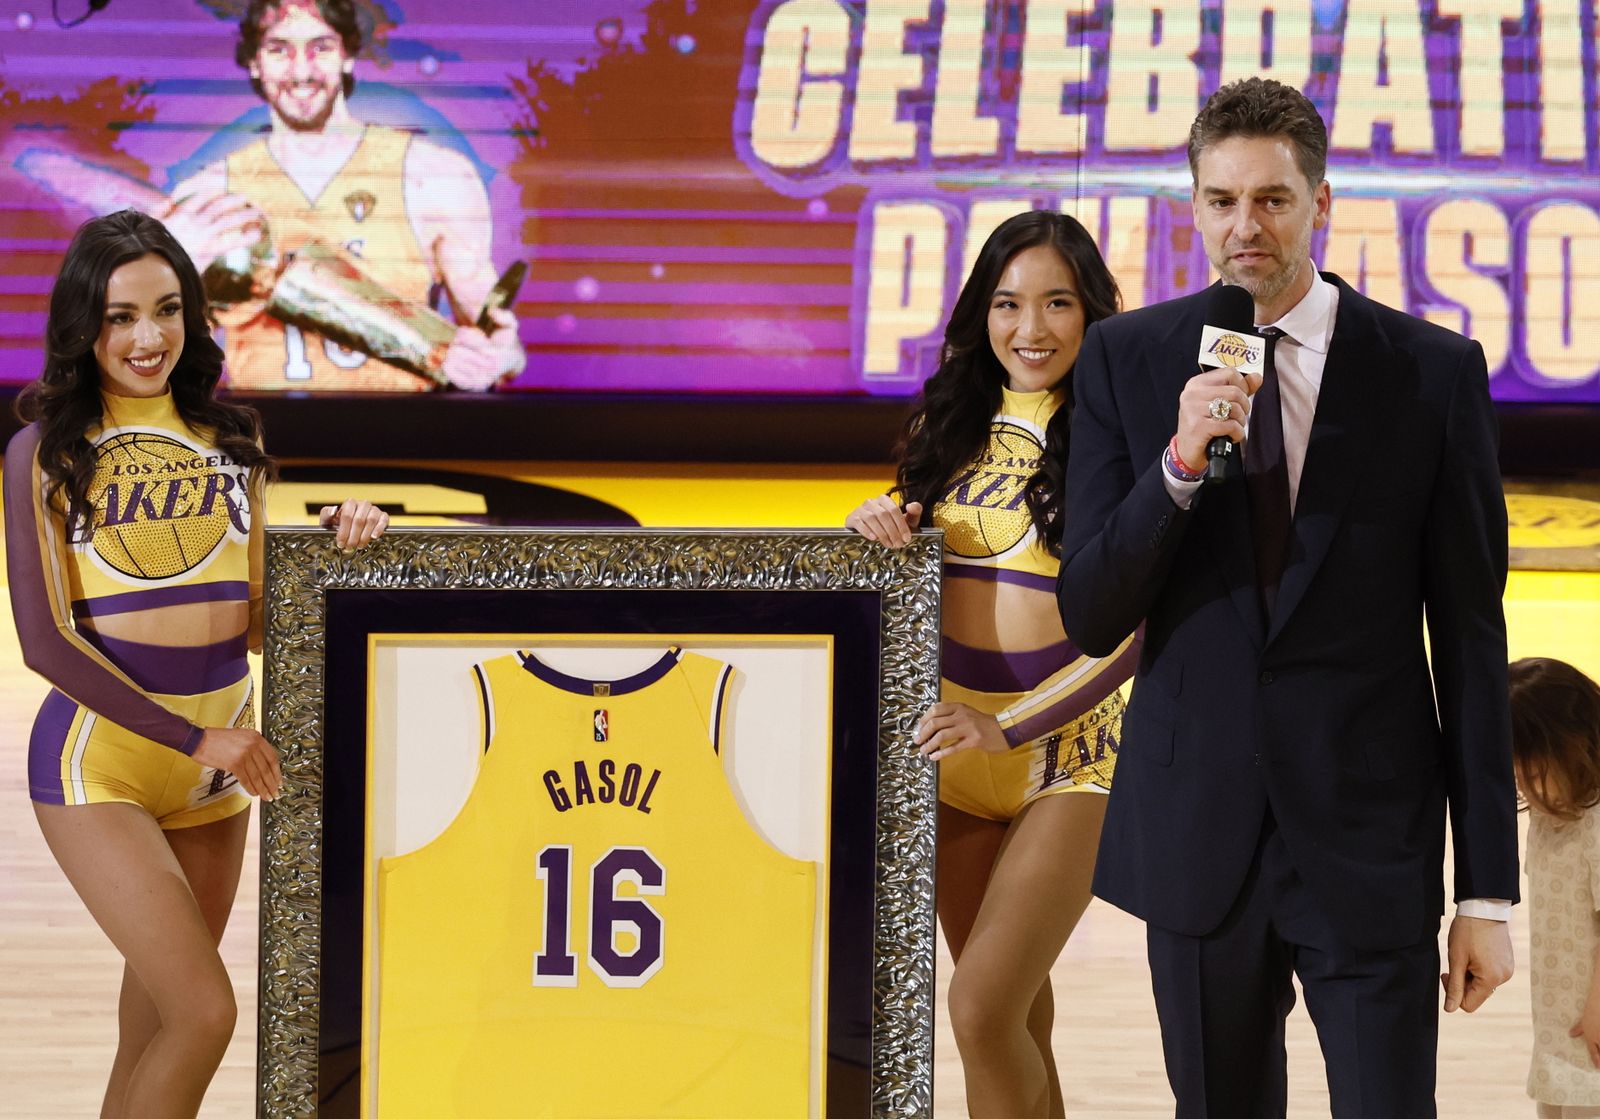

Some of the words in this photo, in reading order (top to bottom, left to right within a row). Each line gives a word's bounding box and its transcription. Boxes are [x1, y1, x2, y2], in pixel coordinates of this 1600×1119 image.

[751, 0, 1600, 168] CELEBRATI
[1207, 338, 1259, 364] LAKERS
[112, 464, 151, 476] LOS
[158, 454, 243, 473] ANGEL
[542, 759, 662, 815] GASOL
[1039, 724, 1121, 792] LAK
[532, 844, 667, 989] 16
